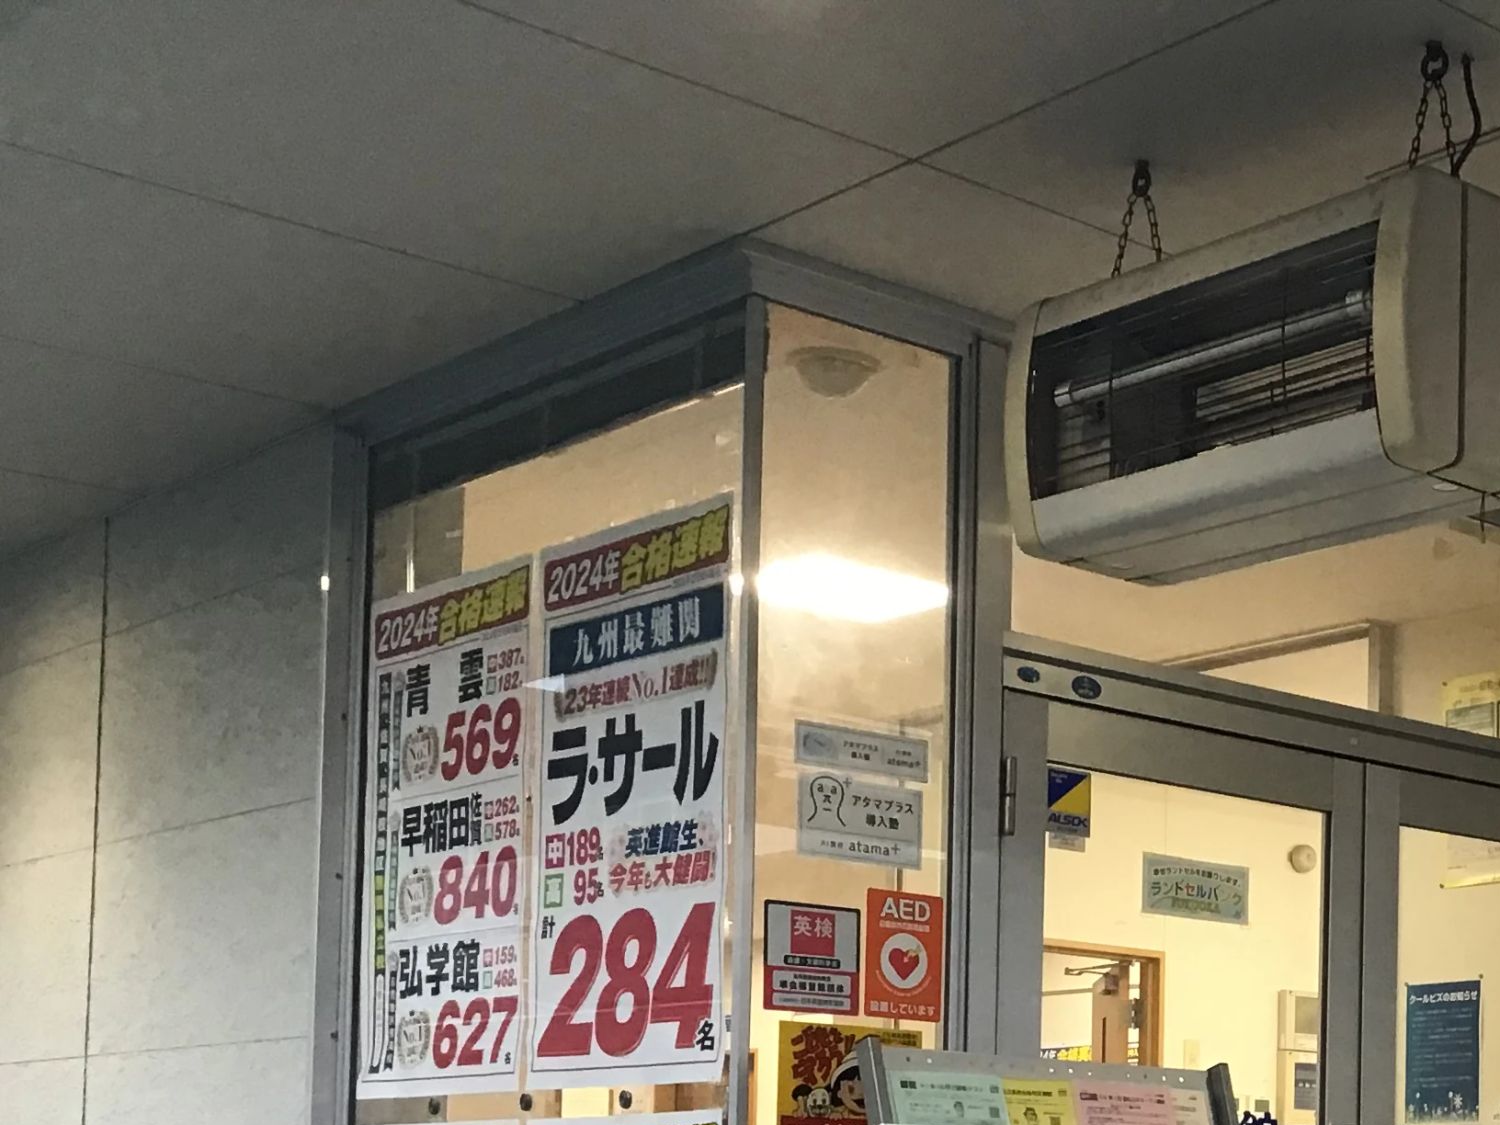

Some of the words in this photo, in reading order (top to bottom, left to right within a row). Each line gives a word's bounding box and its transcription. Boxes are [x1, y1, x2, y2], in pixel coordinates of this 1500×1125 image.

[573, 596, 700, 667] 九州最難関
[851, 794, 914, 815] アタマプラス
[865, 813, 900, 831] 導入塾
[1151, 878, 1242, 907] ランドセルバンク
[880, 896, 931, 922] AED
[793, 914, 833, 939] 英検
[399, 939, 480, 999] 弘学館
